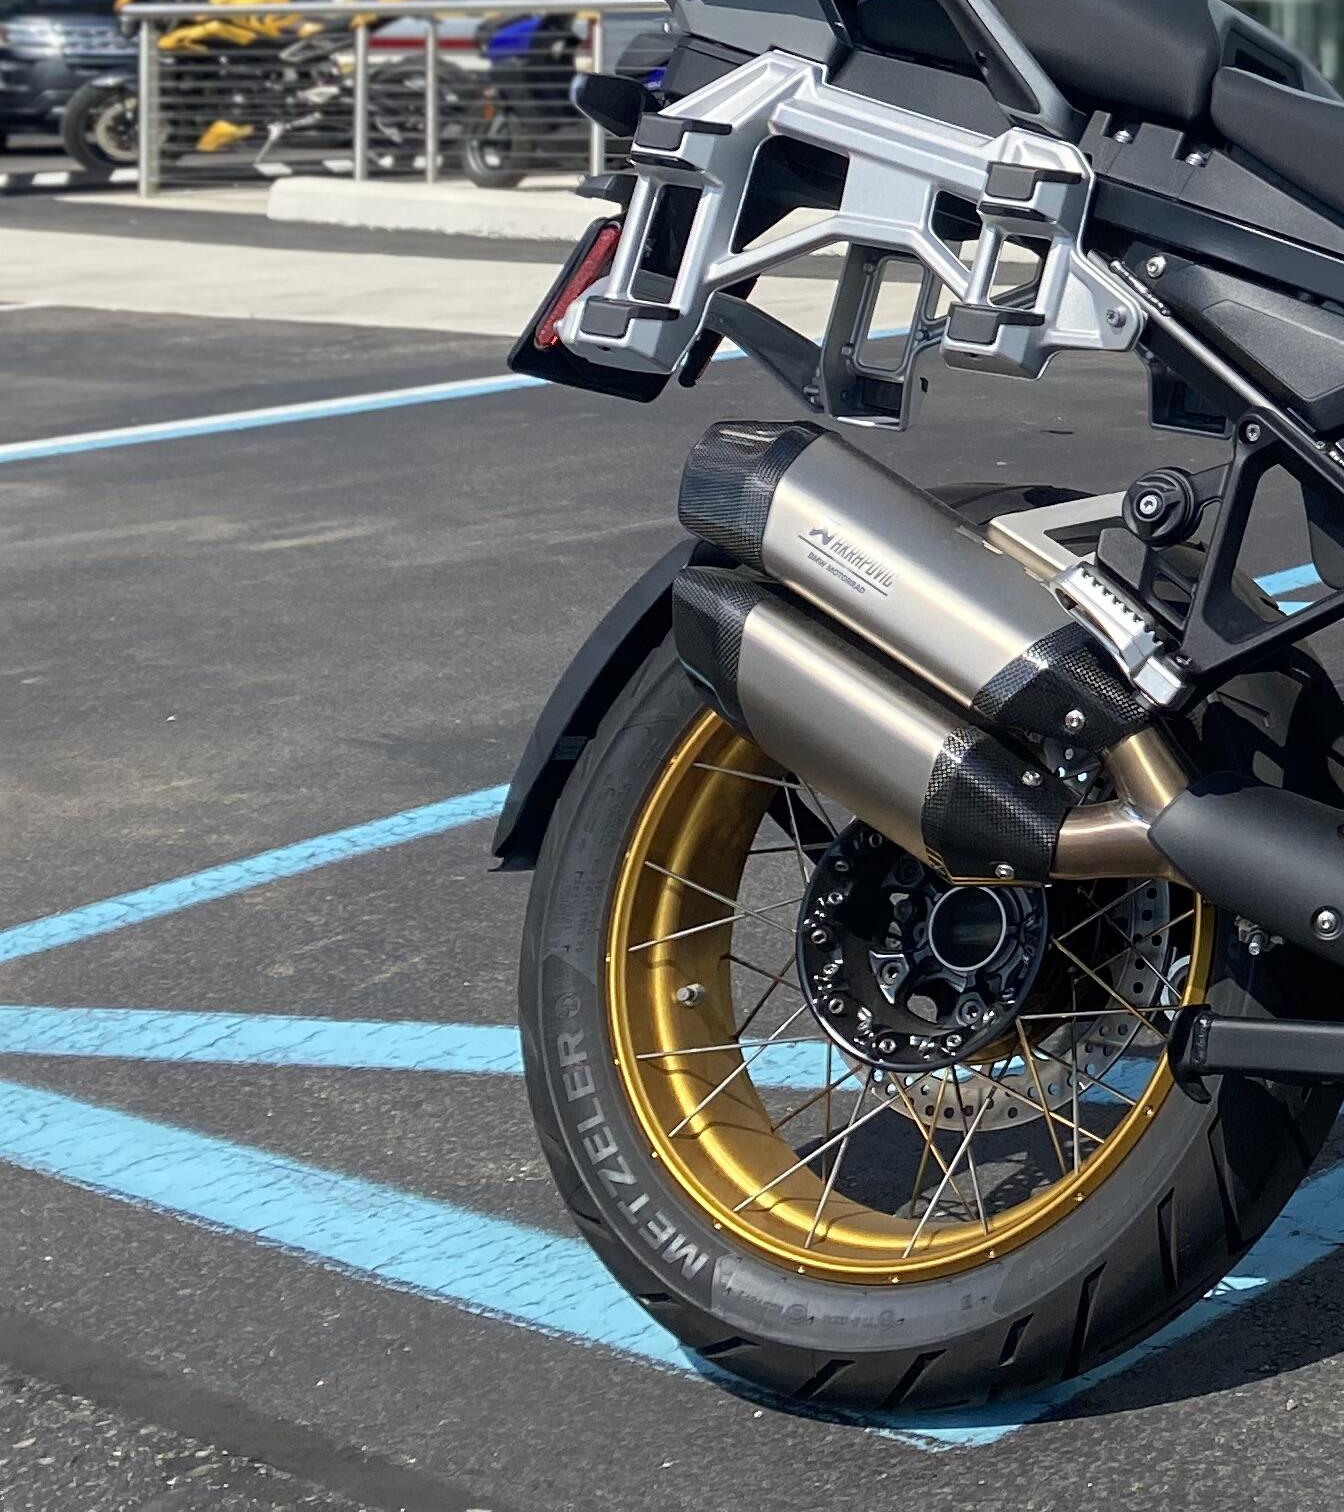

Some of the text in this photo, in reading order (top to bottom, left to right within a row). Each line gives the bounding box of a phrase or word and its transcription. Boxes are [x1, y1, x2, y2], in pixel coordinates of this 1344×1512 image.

[807, 551, 866, 594] BMW MOTORRAD
[556, 1029, 709, 1280] METZELER
